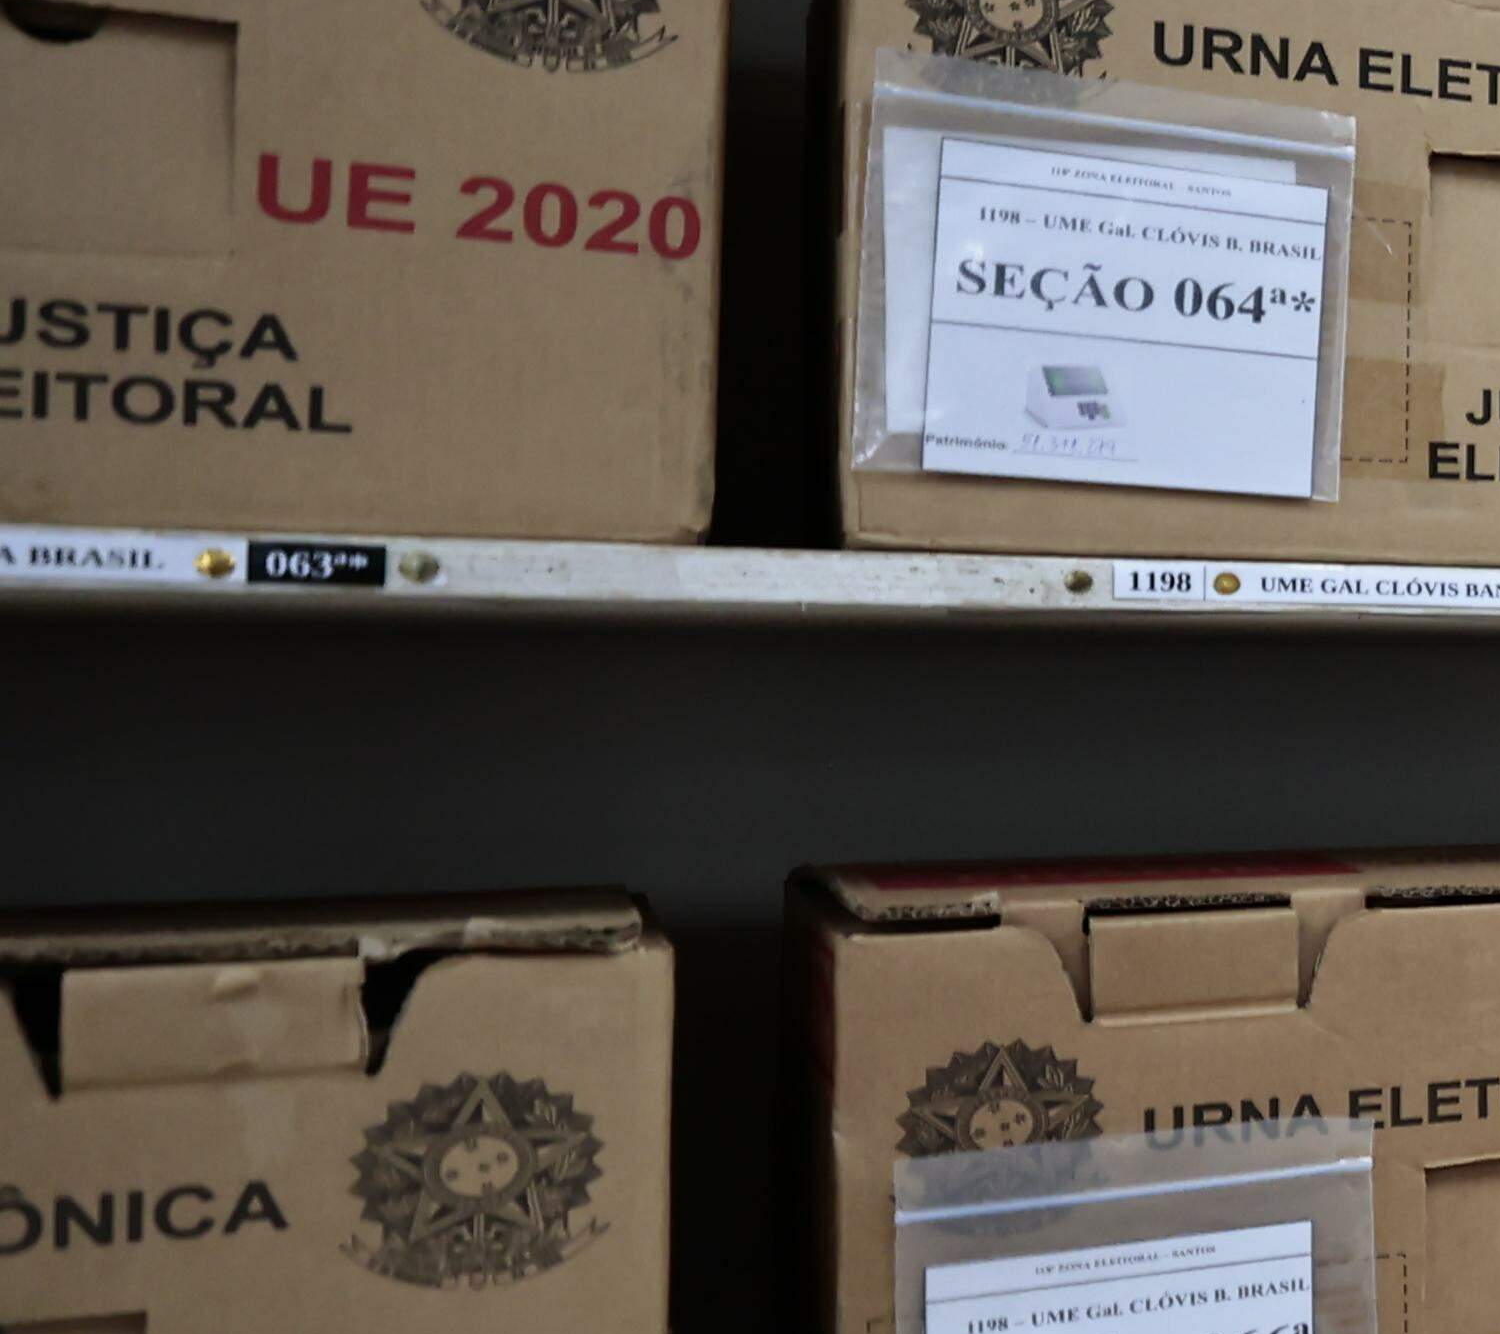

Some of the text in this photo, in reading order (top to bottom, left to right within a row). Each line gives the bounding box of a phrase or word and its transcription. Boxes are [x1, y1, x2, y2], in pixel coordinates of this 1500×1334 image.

[1152, 21, 1340, 87] URNA
[258, 154, 702, 262] UE 2020
[979, 206, 1021, 226] 1198
[1044, 214, 1093, 235] UME
[1142, 226, 1220, 250] CLÓVIS
[1226, 236, 1244, 252] B.
[1249, 239, 1321, 262] BRASIL
[956, 259, 1154, 312] SEÇÃO
[1127, 568, 1192, 594] 1198
[1259, 576, 1312, 594] UME
[1318, 577, 1368, 596] GAL
[1374, 575, 1458, 599] CLÓVIS
[1143, 1093, 1331, 1152] URNA
